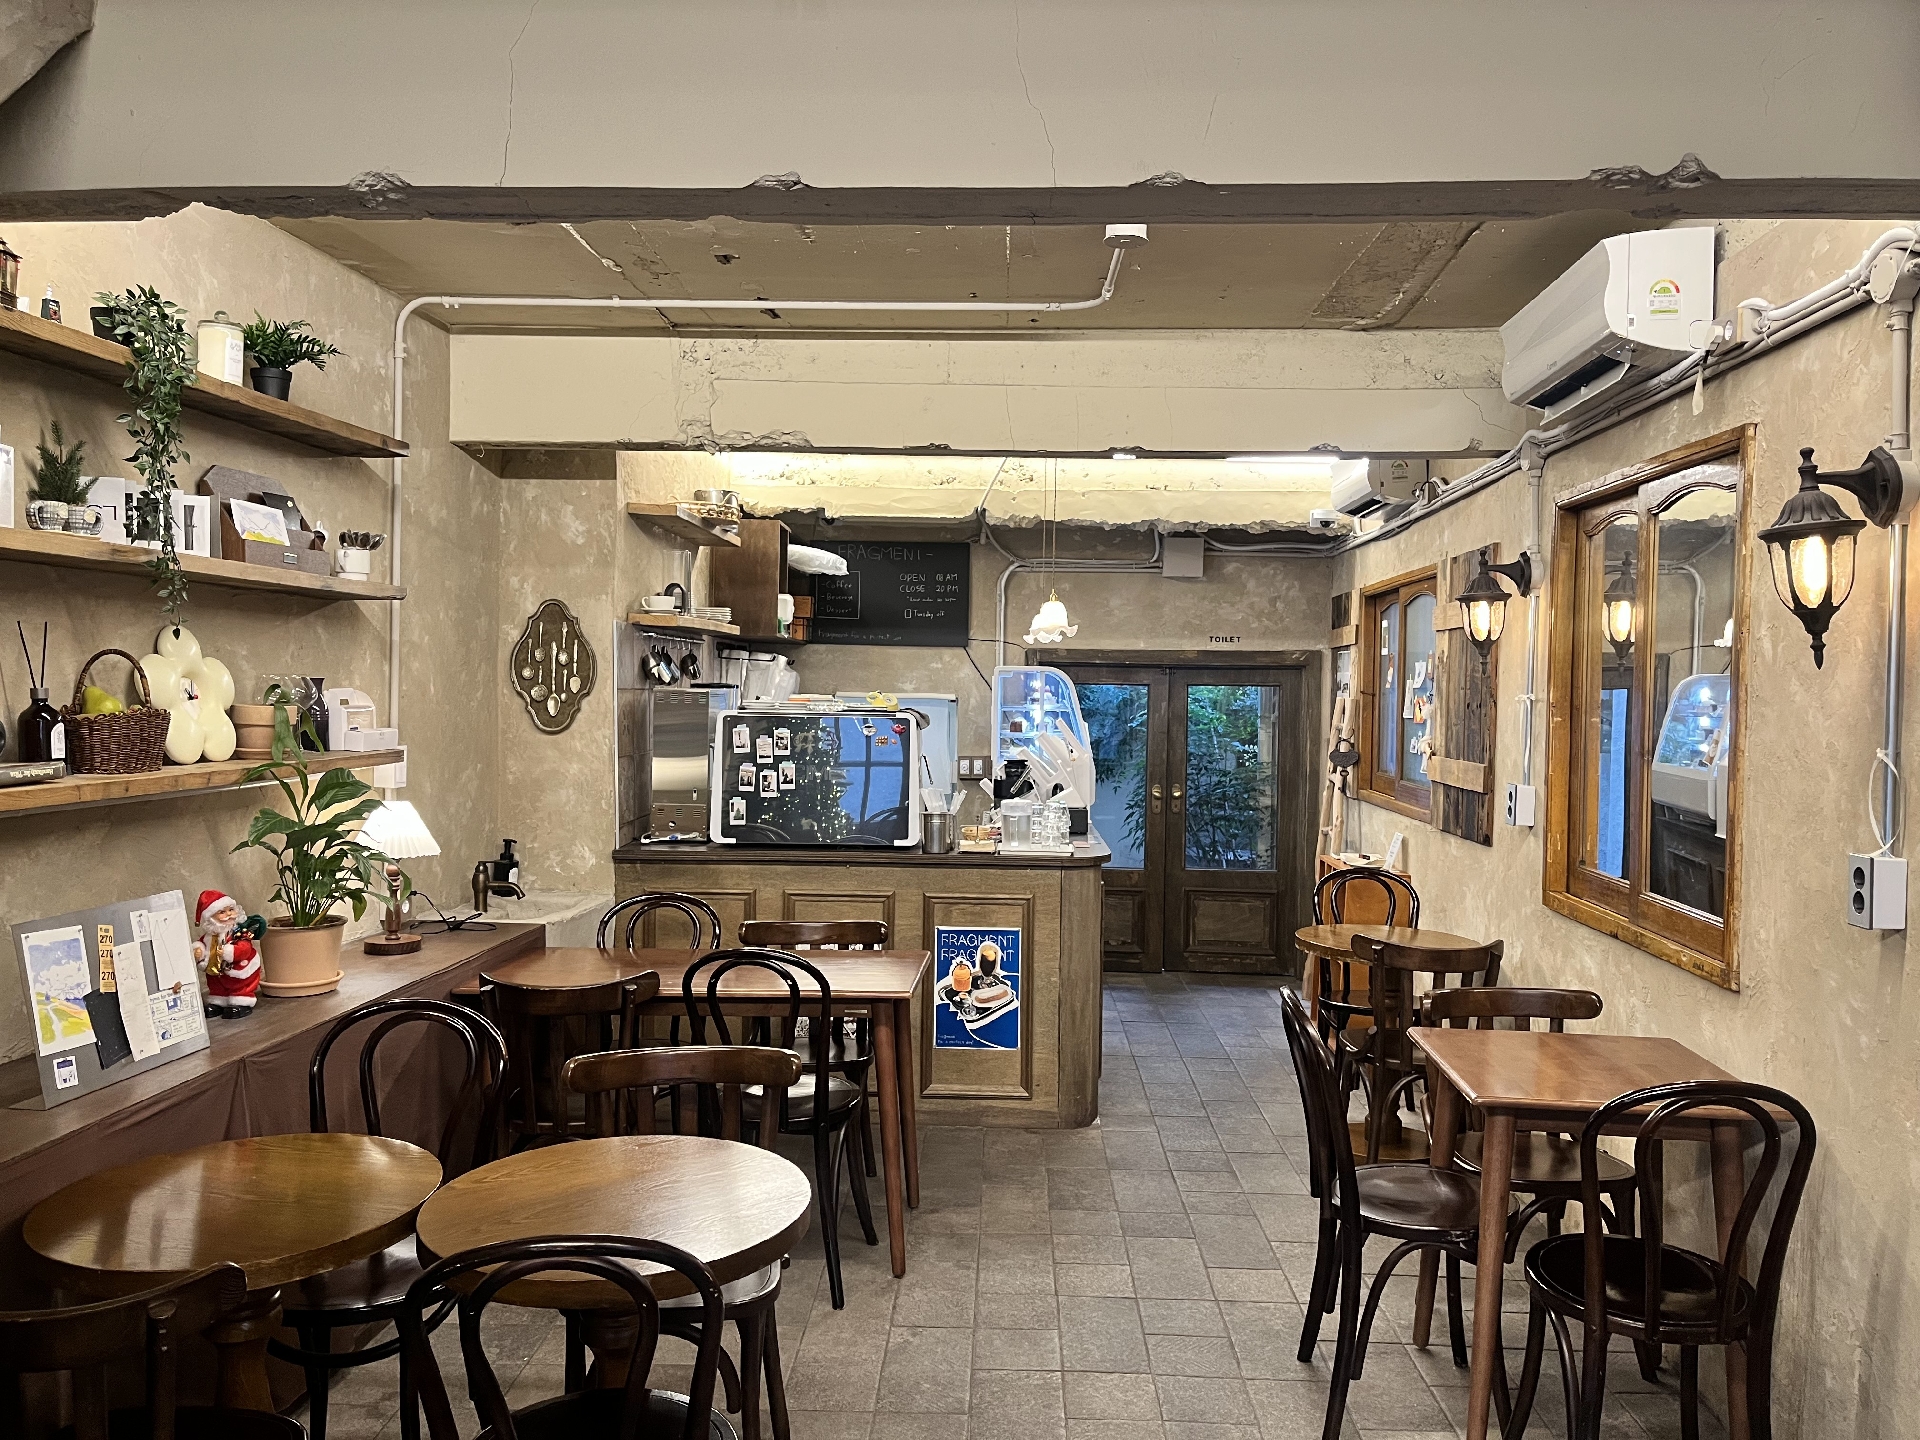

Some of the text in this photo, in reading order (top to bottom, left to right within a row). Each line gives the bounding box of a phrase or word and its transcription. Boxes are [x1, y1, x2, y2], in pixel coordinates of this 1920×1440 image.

[899, 573, 926, 582] OPEN
[945, 573, 958, 581] AM
[899, 584, 959, 593] CLOSE 20 PM
[100, 934, 113, 944] 270
[941, 934, 1015, 947] FRAGMENT
[941, 948, 1015, 961] FRAGNT
[101, 971, 115, 981] 270
